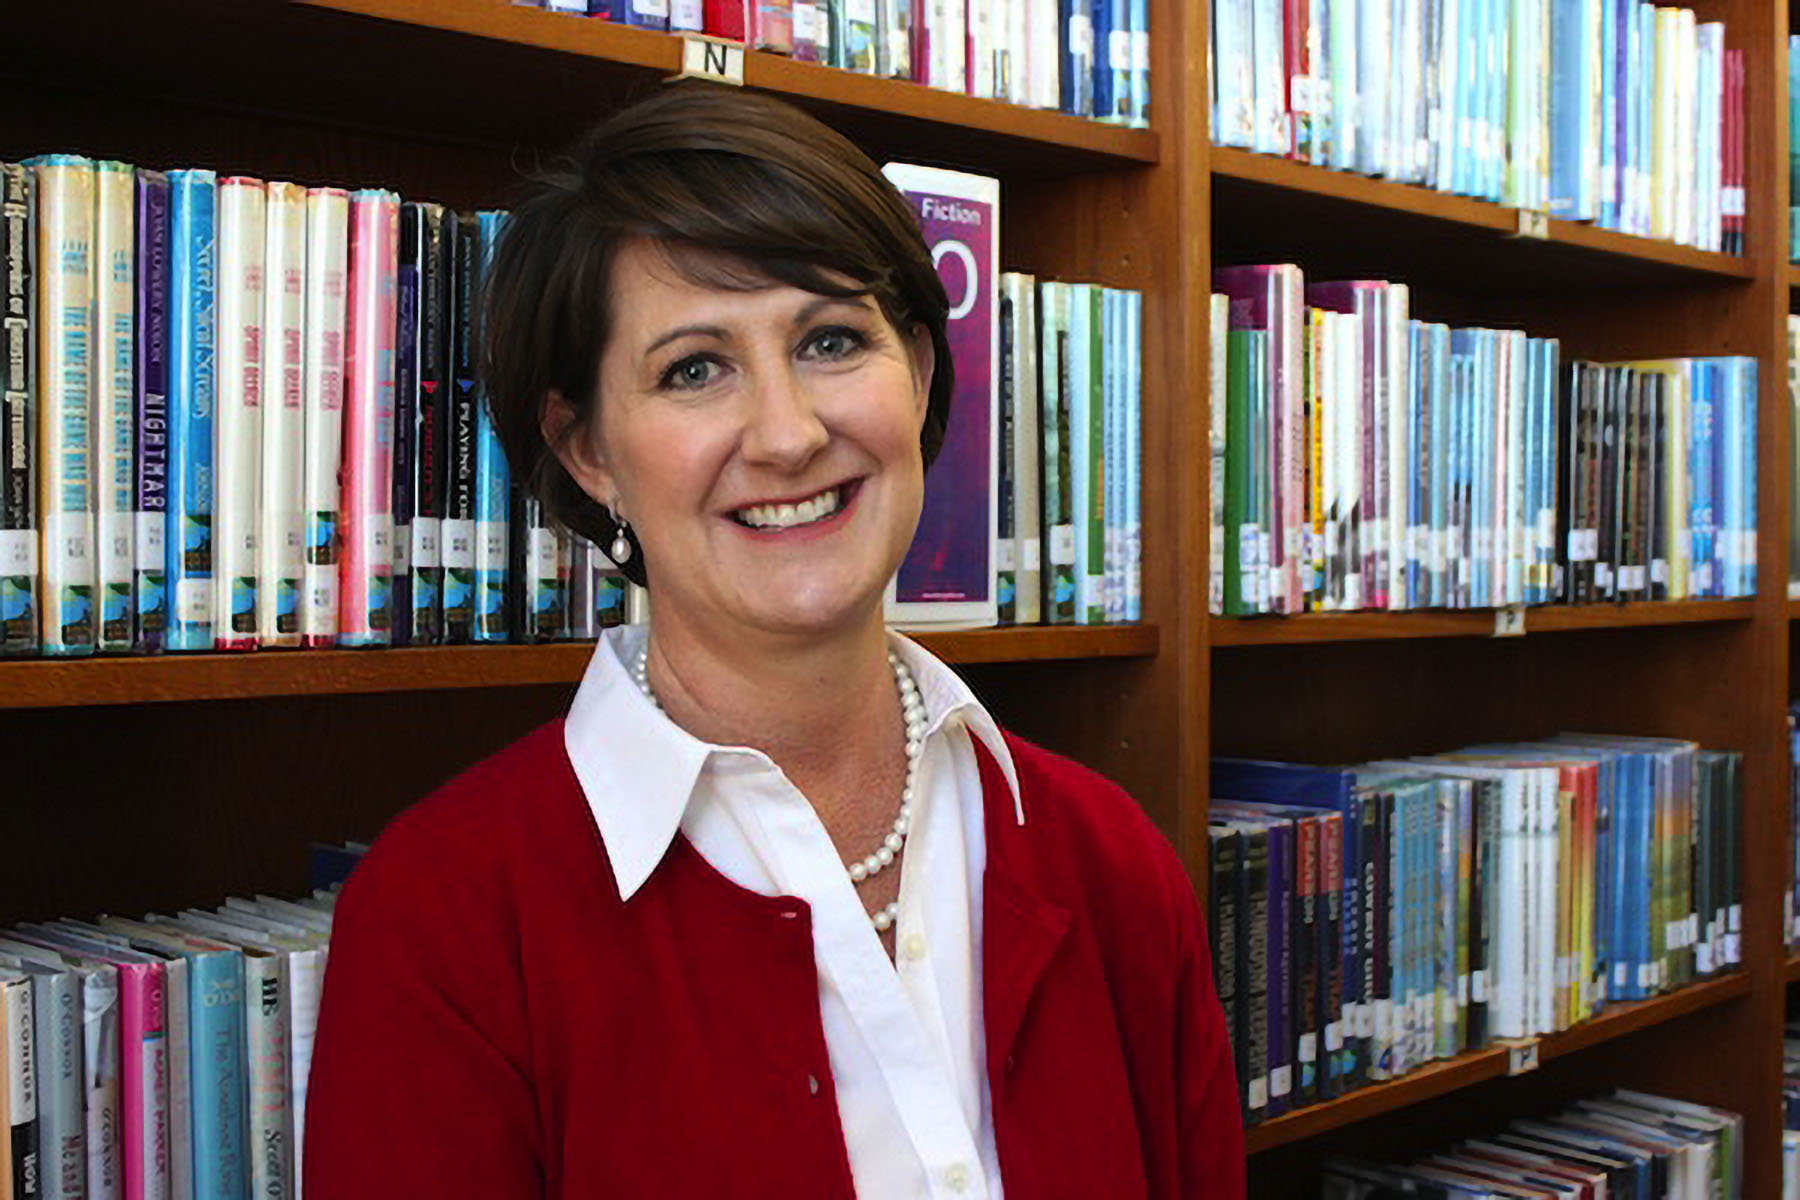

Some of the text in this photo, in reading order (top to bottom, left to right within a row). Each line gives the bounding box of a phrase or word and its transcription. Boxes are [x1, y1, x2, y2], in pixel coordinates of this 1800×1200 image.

[703, 42, 727, 75] N
[922, 198, 981, 226] Fiction
[931, 240, 978, 319] O
